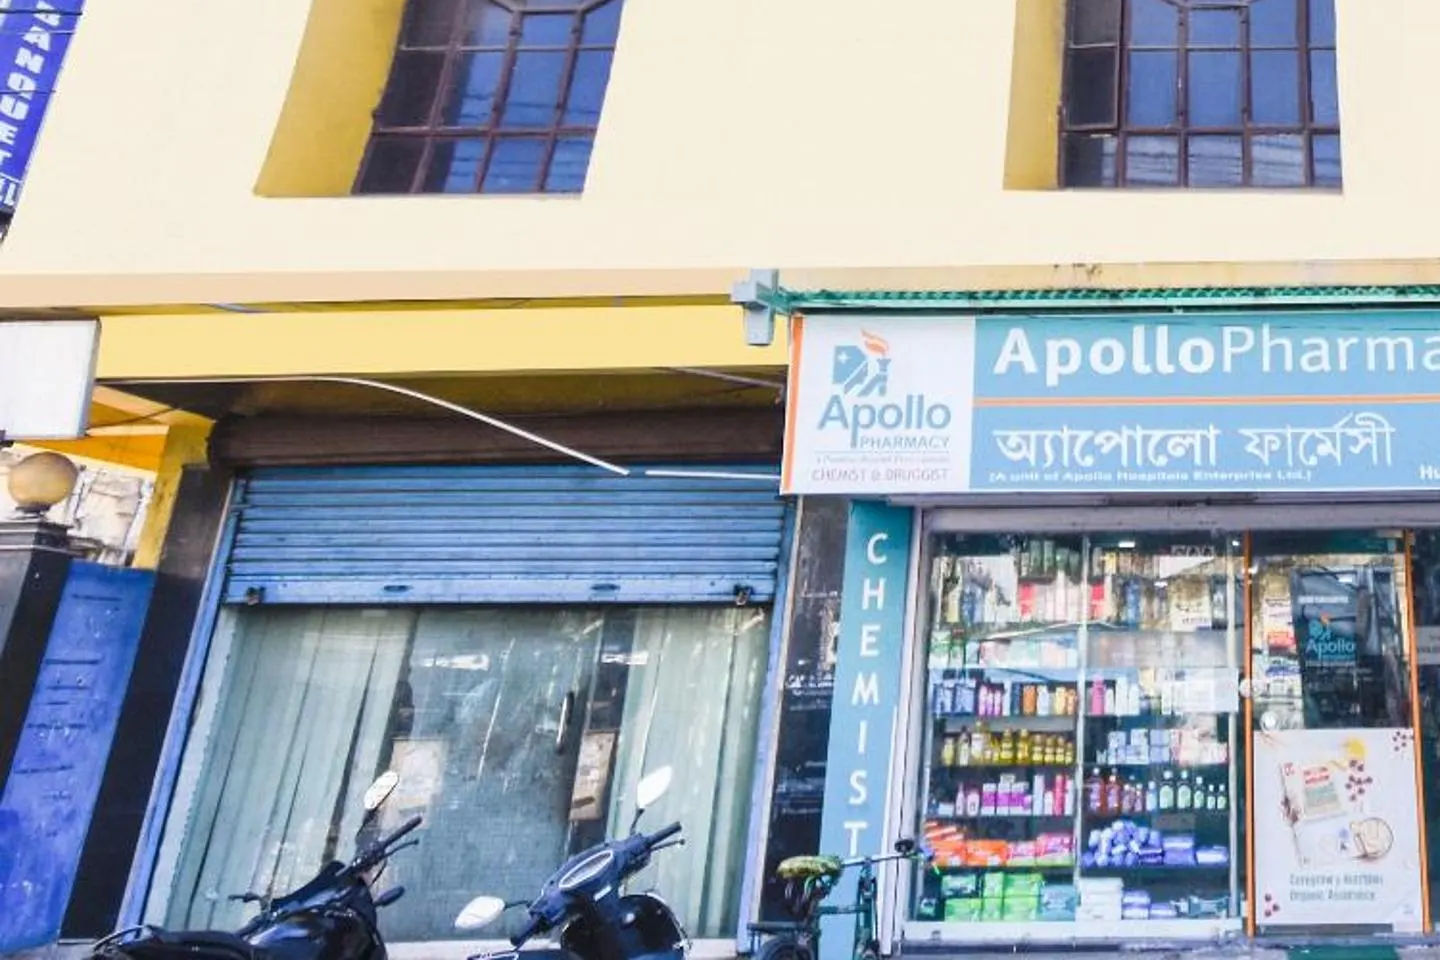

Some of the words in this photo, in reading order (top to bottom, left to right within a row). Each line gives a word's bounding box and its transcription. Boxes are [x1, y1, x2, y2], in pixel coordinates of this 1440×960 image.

[817, 394, 951, 448] Apollo
[859, 435, 950, 449] PHARMACY
[992, 423, 1221, 468] অ্যাপোলো
[1238, 411, 1395, 467] ফার্মেসী
[1305, 638, 1355, 660] Apollo
[843, 532, 888, 857] CHEMIST
